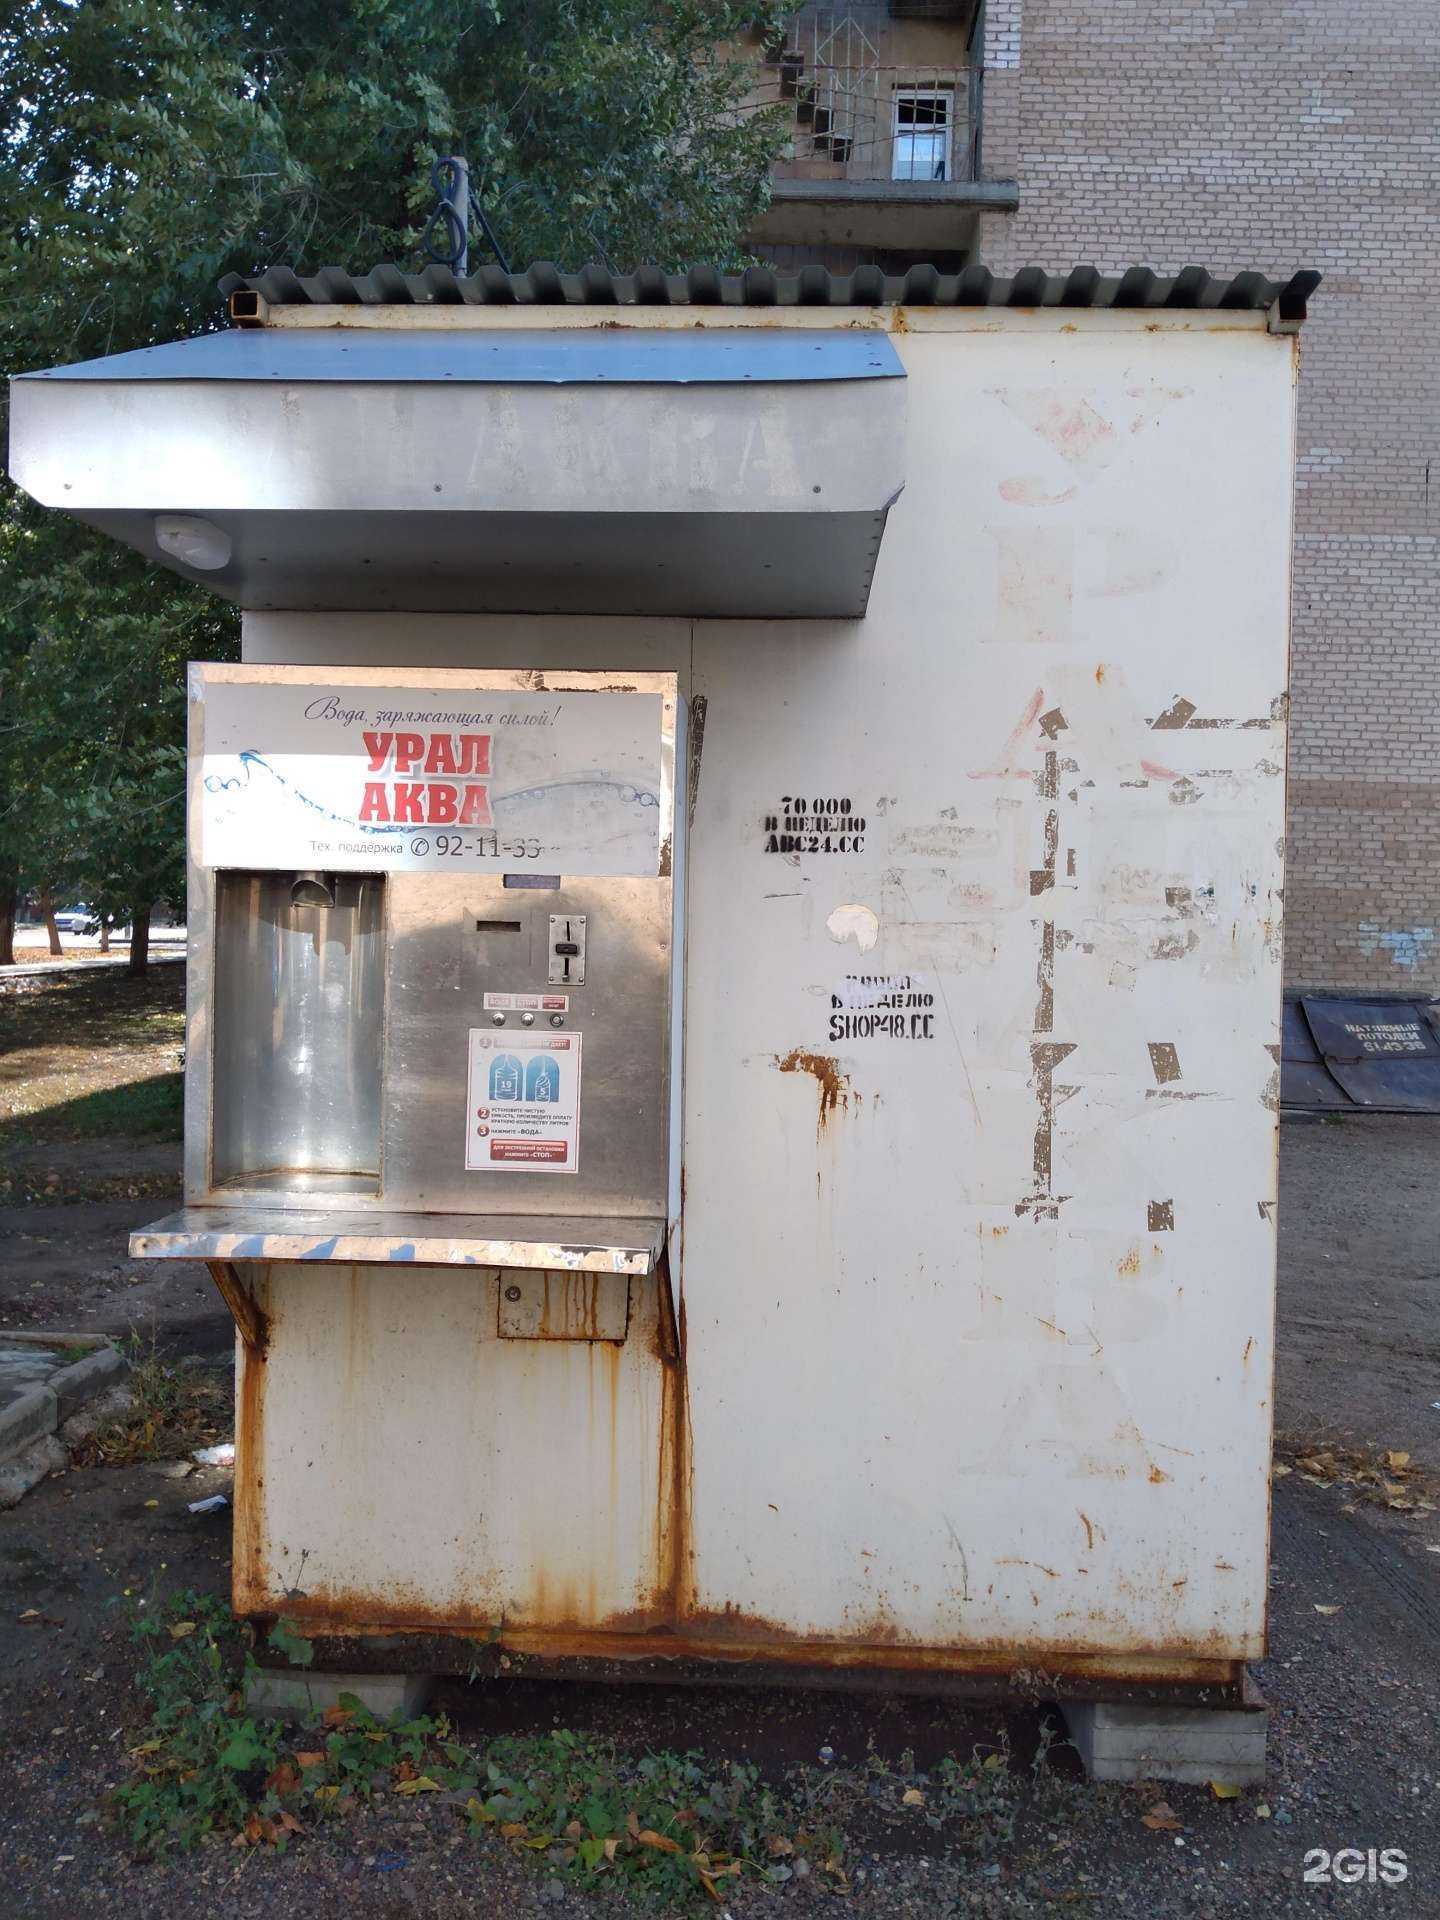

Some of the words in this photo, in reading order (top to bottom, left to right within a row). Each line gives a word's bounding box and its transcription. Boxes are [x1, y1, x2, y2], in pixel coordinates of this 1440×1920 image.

[304, 696, 368, 727] Вода,
[370, 707, 494, 728] заряжающая
[499, 705, 562, 727] силой!
[363, 731, 491, 775] УРАЛ
[358, 782, 491, 825] АКВА
[338, 841, 403, 855] поддержка
